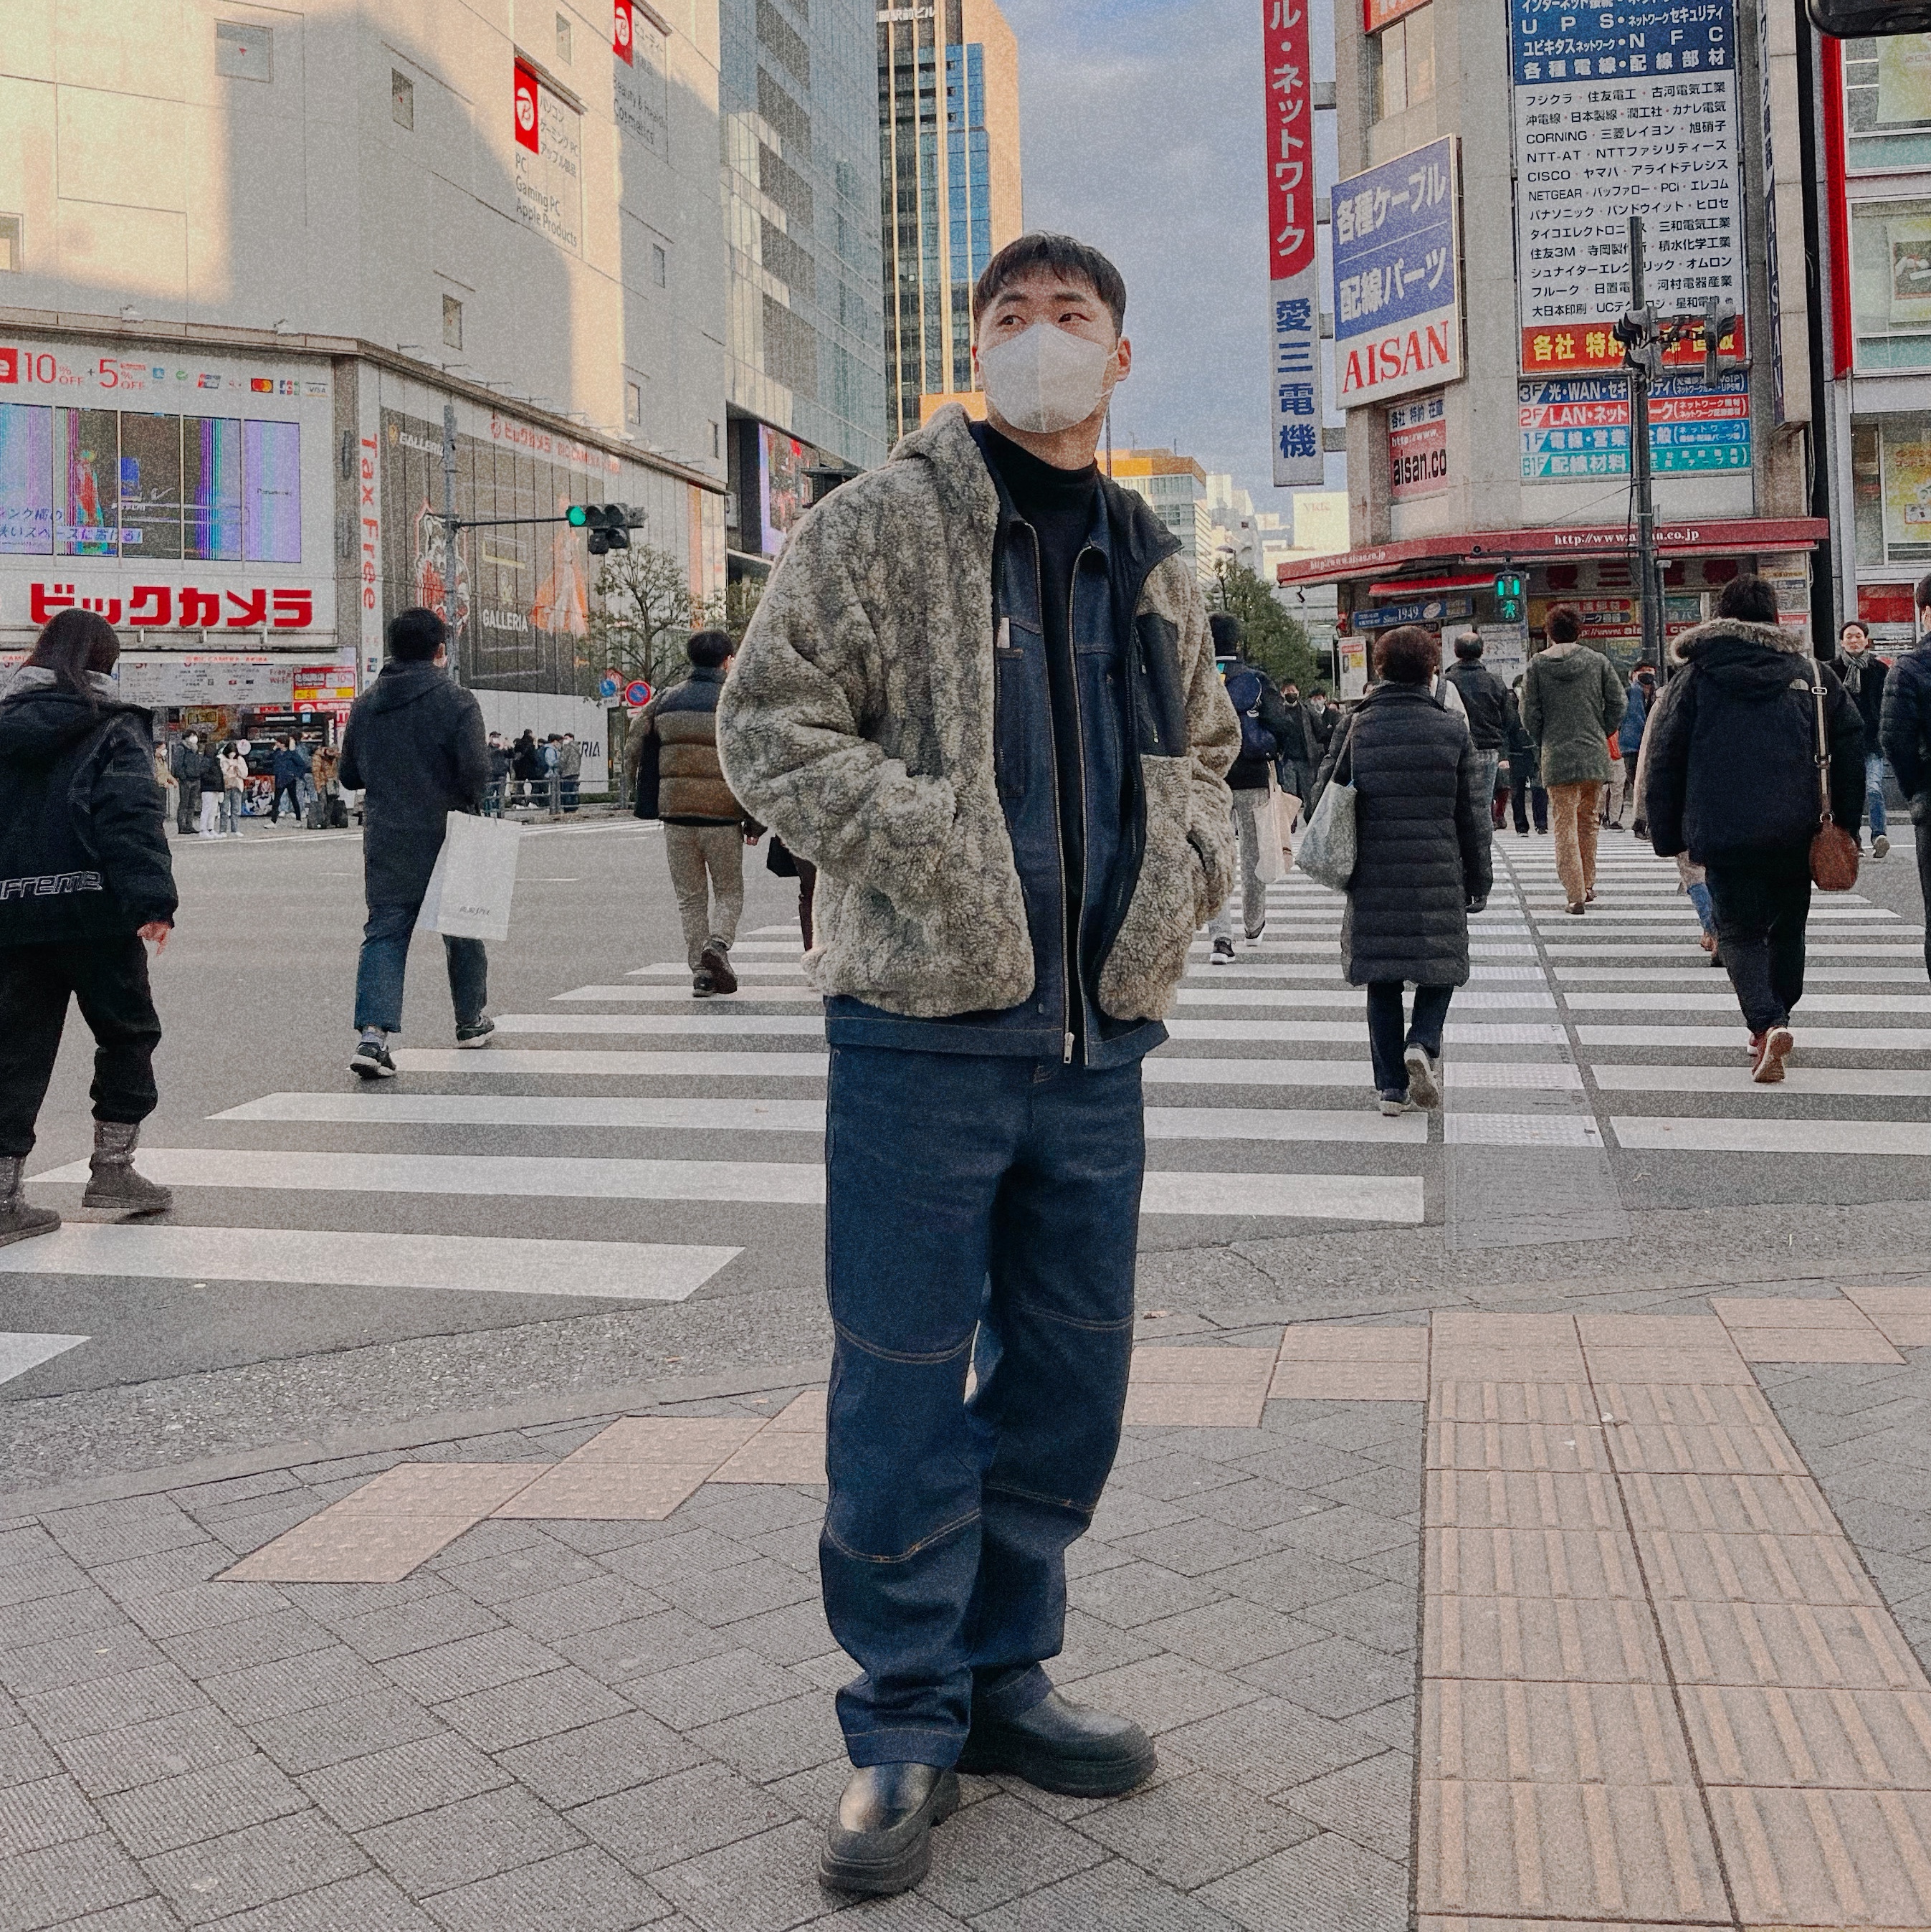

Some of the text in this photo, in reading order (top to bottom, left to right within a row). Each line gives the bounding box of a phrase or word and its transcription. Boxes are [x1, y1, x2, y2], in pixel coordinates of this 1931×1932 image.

[1525, 130, 1588, 145] CORNING
[1527, 169, 1571, 183] CISCO
[1528, 188, 1582, 202] NETGEAR
[1531, 259, 1674, 278] シュナイダーエレクリック
[1342, 320, 1450, 394] AISAN
[1533, 333, 1575, 361] 各社
[24, 352, 57, 385] 10
[99, 358, 118, 389] 5
[1276, 297, 1317, 459] 愛三電機
[1393, 448, 1446, 487] aisan.co
[361, 434, 379, 609] Tax Free
[1555, 528, 1699, 547] http://www.an.co.jp
[30, 582, 313, 627] ビックカメラ
[482, 607, 528, 634] GALLERIA
